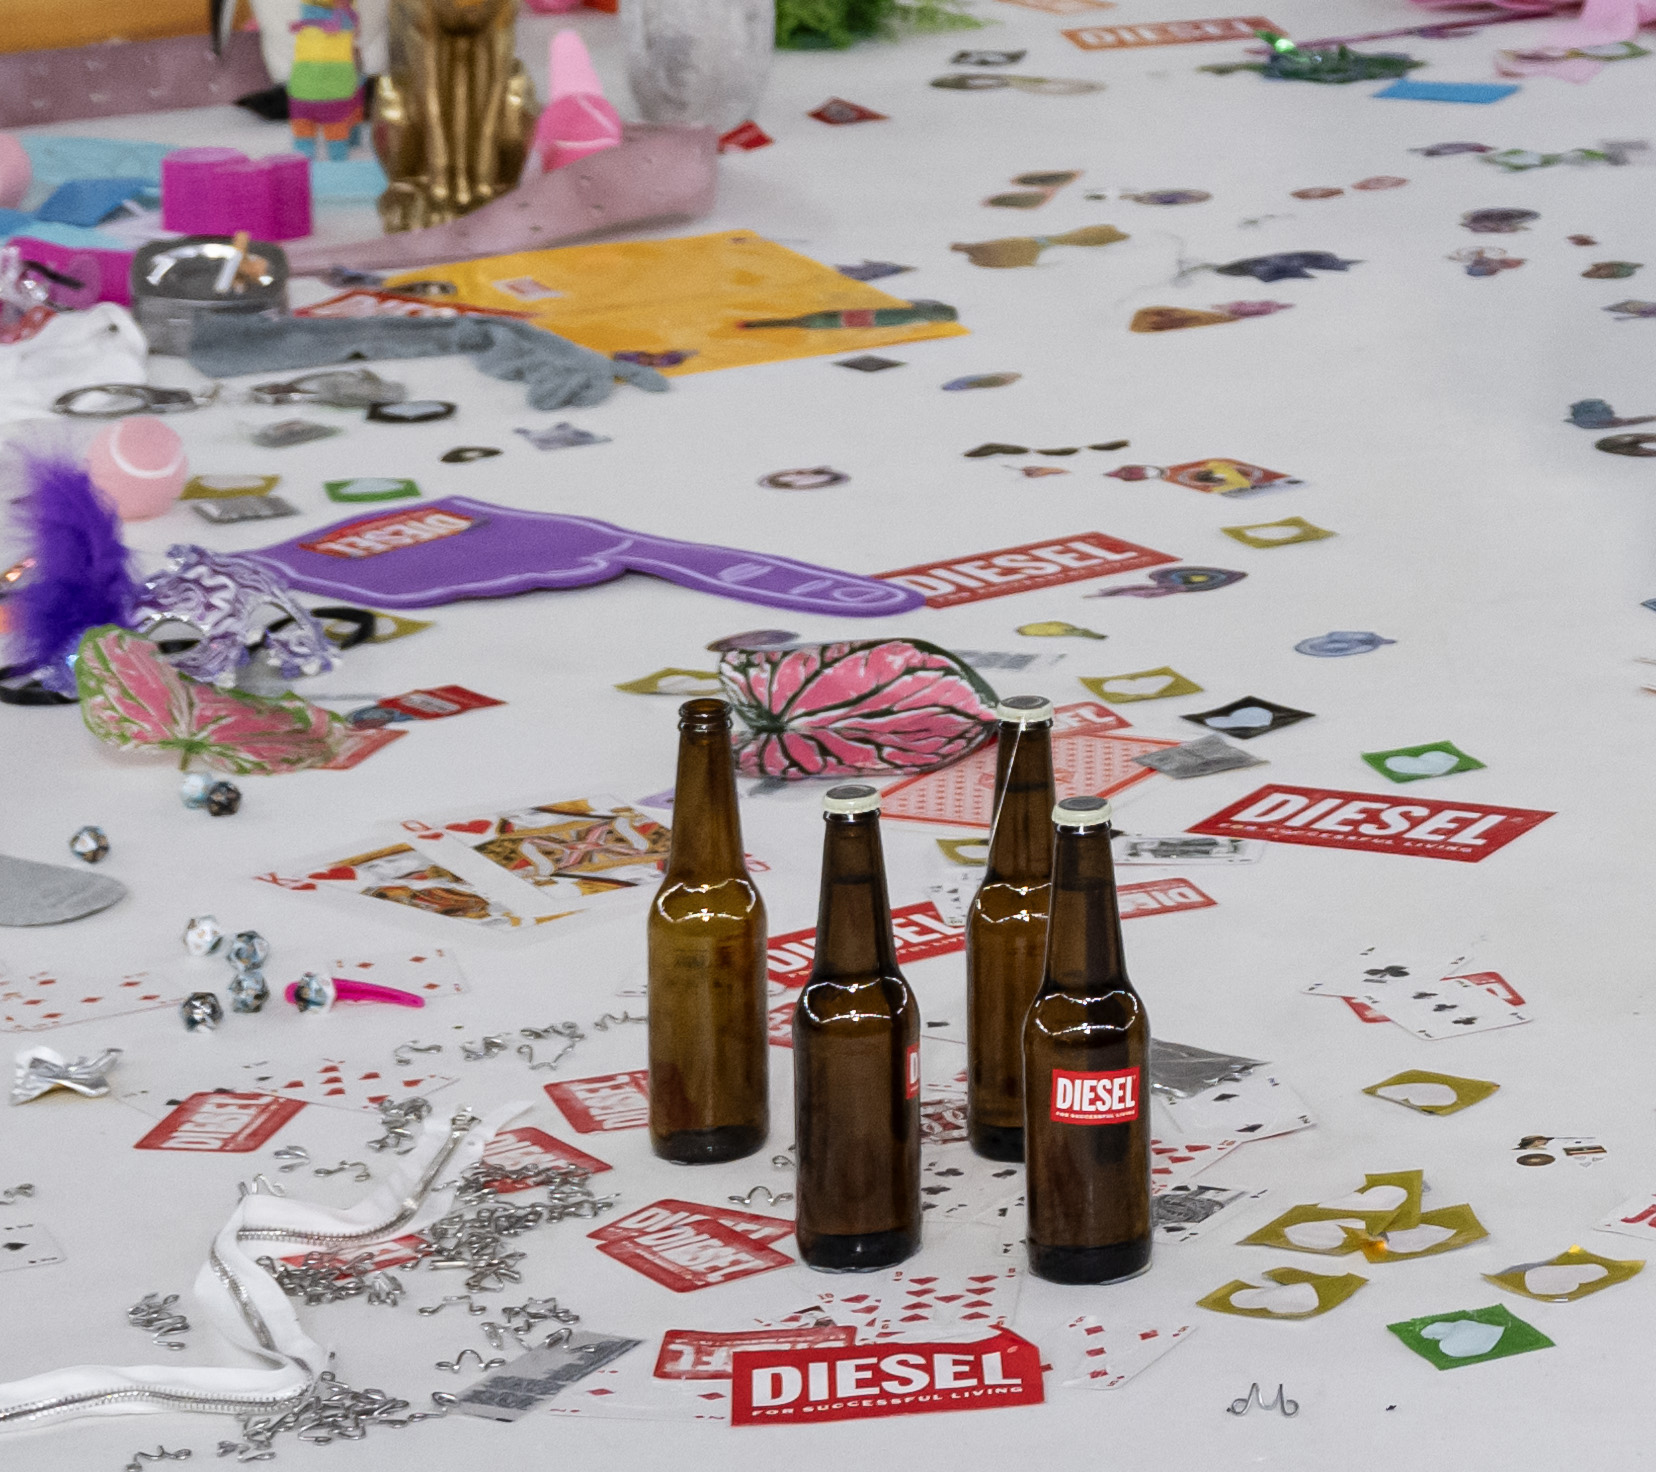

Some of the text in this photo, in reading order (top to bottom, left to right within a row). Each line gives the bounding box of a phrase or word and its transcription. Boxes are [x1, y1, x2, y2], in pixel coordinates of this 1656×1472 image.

[909, 539, 1140, 598] DIESEL
[1230, 792, 1512, 846] DIESEL
[1056, 1075, 1136, 1112] DIESEL
[752, 1350, 1022, 1408] DIESEL
[752, 1385, 1024, 1417] FOR SUCCESSFUL LIVING
